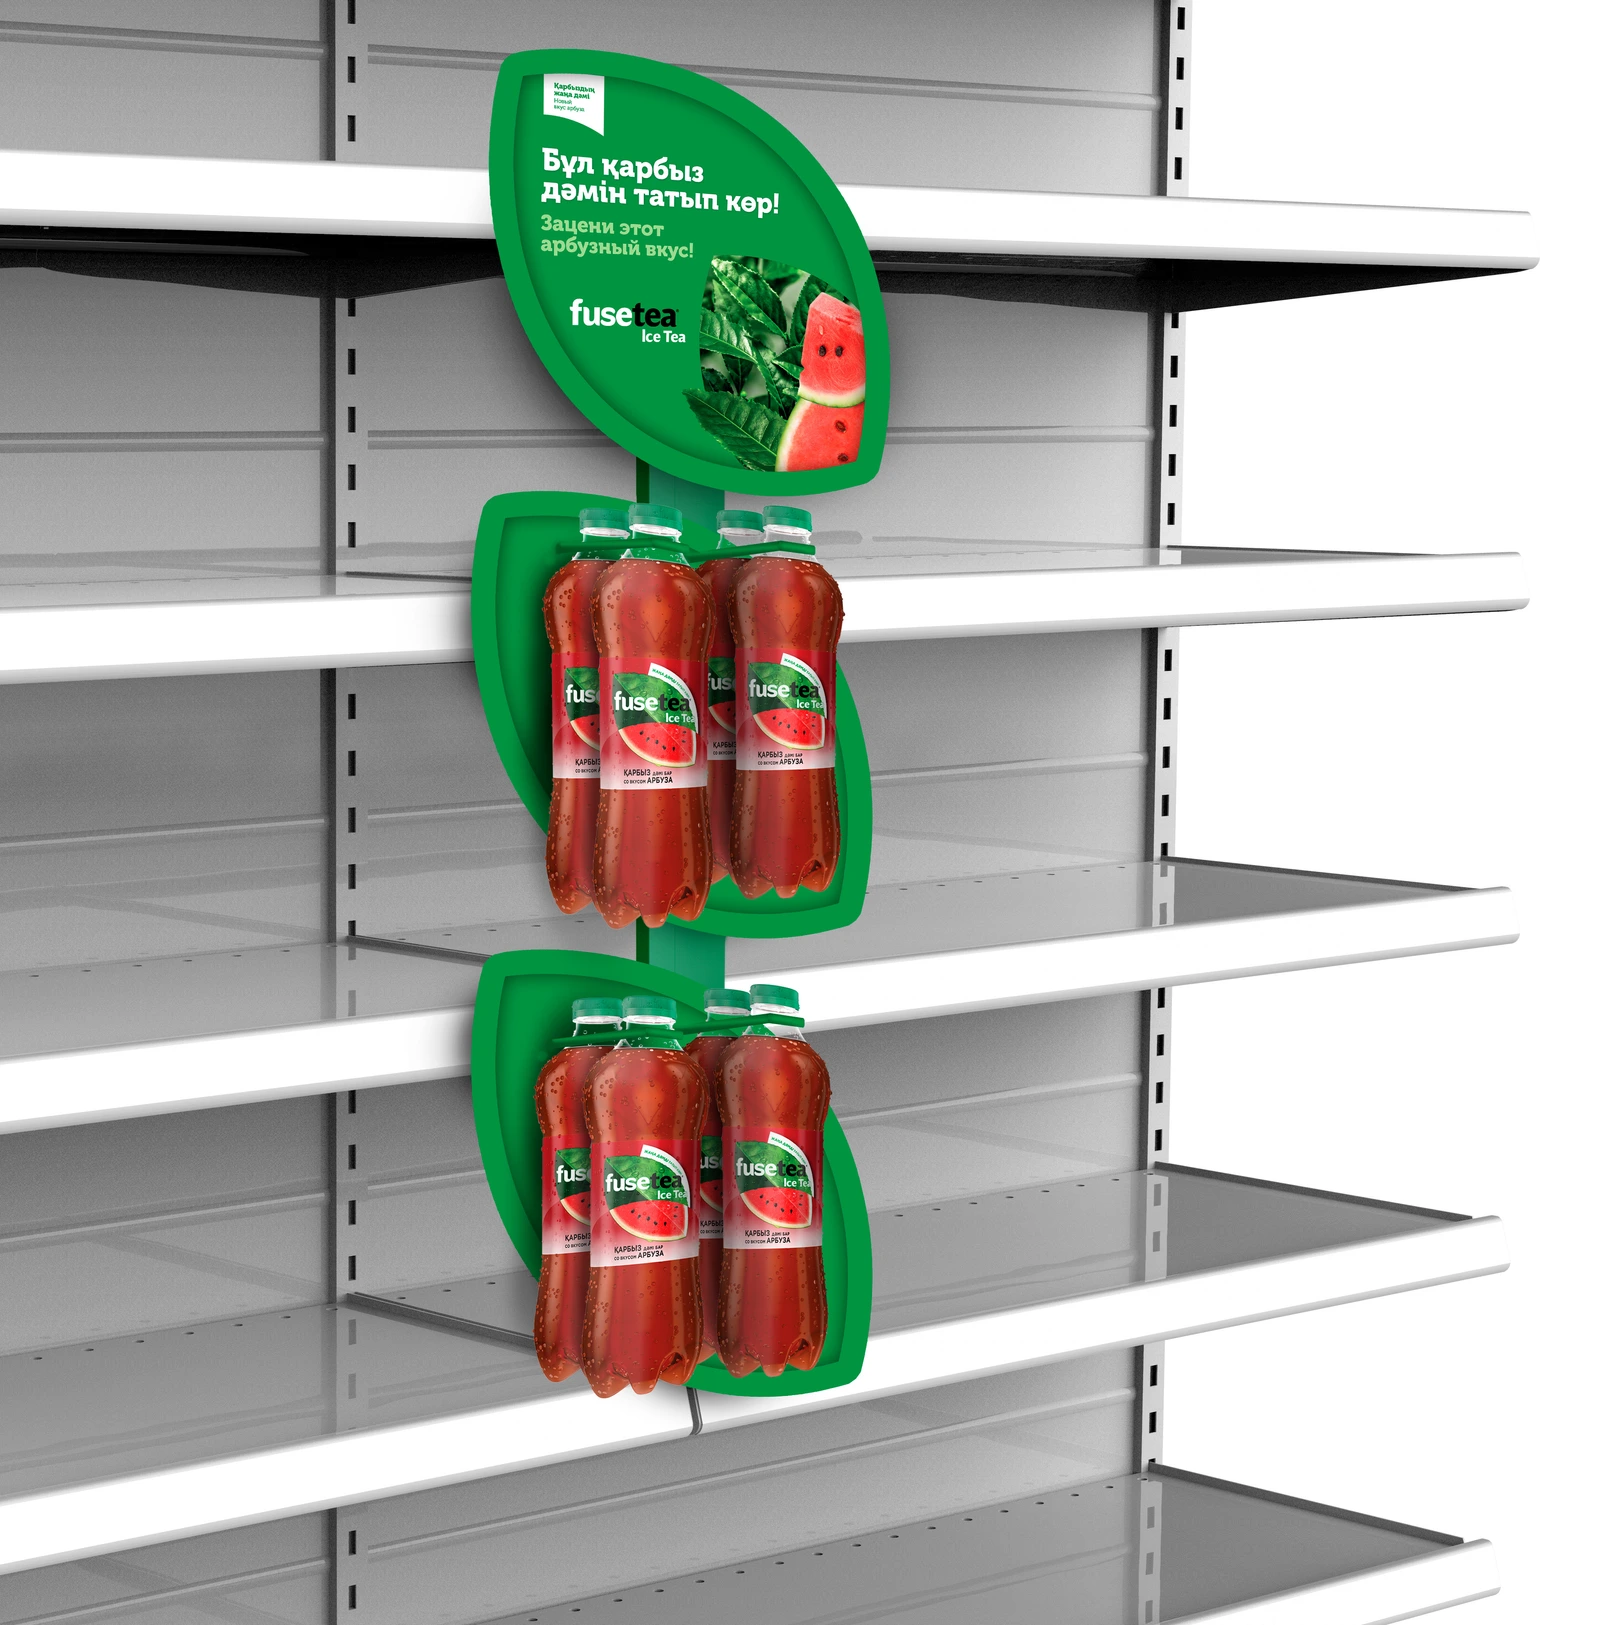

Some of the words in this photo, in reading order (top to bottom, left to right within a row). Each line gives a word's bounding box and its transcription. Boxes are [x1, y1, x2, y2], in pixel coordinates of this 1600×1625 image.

[542, 147, 595, 178] Бұл
[602, 157, 704, 184] қарбыз
[541, 180, 627, 204] дәмін
[633, 188, 719, 210] татып
[725, 193, 780, 218] көр!
[541, 214, 615, 235] Зацени
[619, 222, 665, 237] этот
[541, 236, 641, 257] арбузный
[645, 243, 694, 261] вкус!
[569, 298, 678, 328] fusetea
[641, 329, 661, 343] Ice
[663, 330, 687, 343] Tea
[566, 684, 600, 703] fus
[748, 679, 820, 698] fusetea
[613, 691, 691, 712] fusetea
[796, 699, 810, 709] Ice
[811, 700, 825, 709] Tea
[665, 712, 680, 723] Ice
[681, 713, 696, 723] Tea
[757, 751, 783, 759] ҚАРБЫЗ
[623, 769, 651, 777] ҚАРБЫЗ
[647, 776, 674, 784] АРБУЗА
[556, 1165, 590, 1183] fus
[736, 1157, 807, 1177] fusetea
[605, 1172, 683, 1193] fusetea
[783, 1177, 797, 1187] Ice
[798, 1178, 811, 1187] Tea
[657, 1189, 671, 1200] Ice
[672, 1189, 688, 1199] Tea
[744, 1229, 770, 1238] ҚАРБЫЗ
[766, 1236, 791, 1244] АРБУЗА
[614, 1245, 642, 1254] ҚАРБЫЗ
[638, 1250, 665, 1259] АРБУЗА
